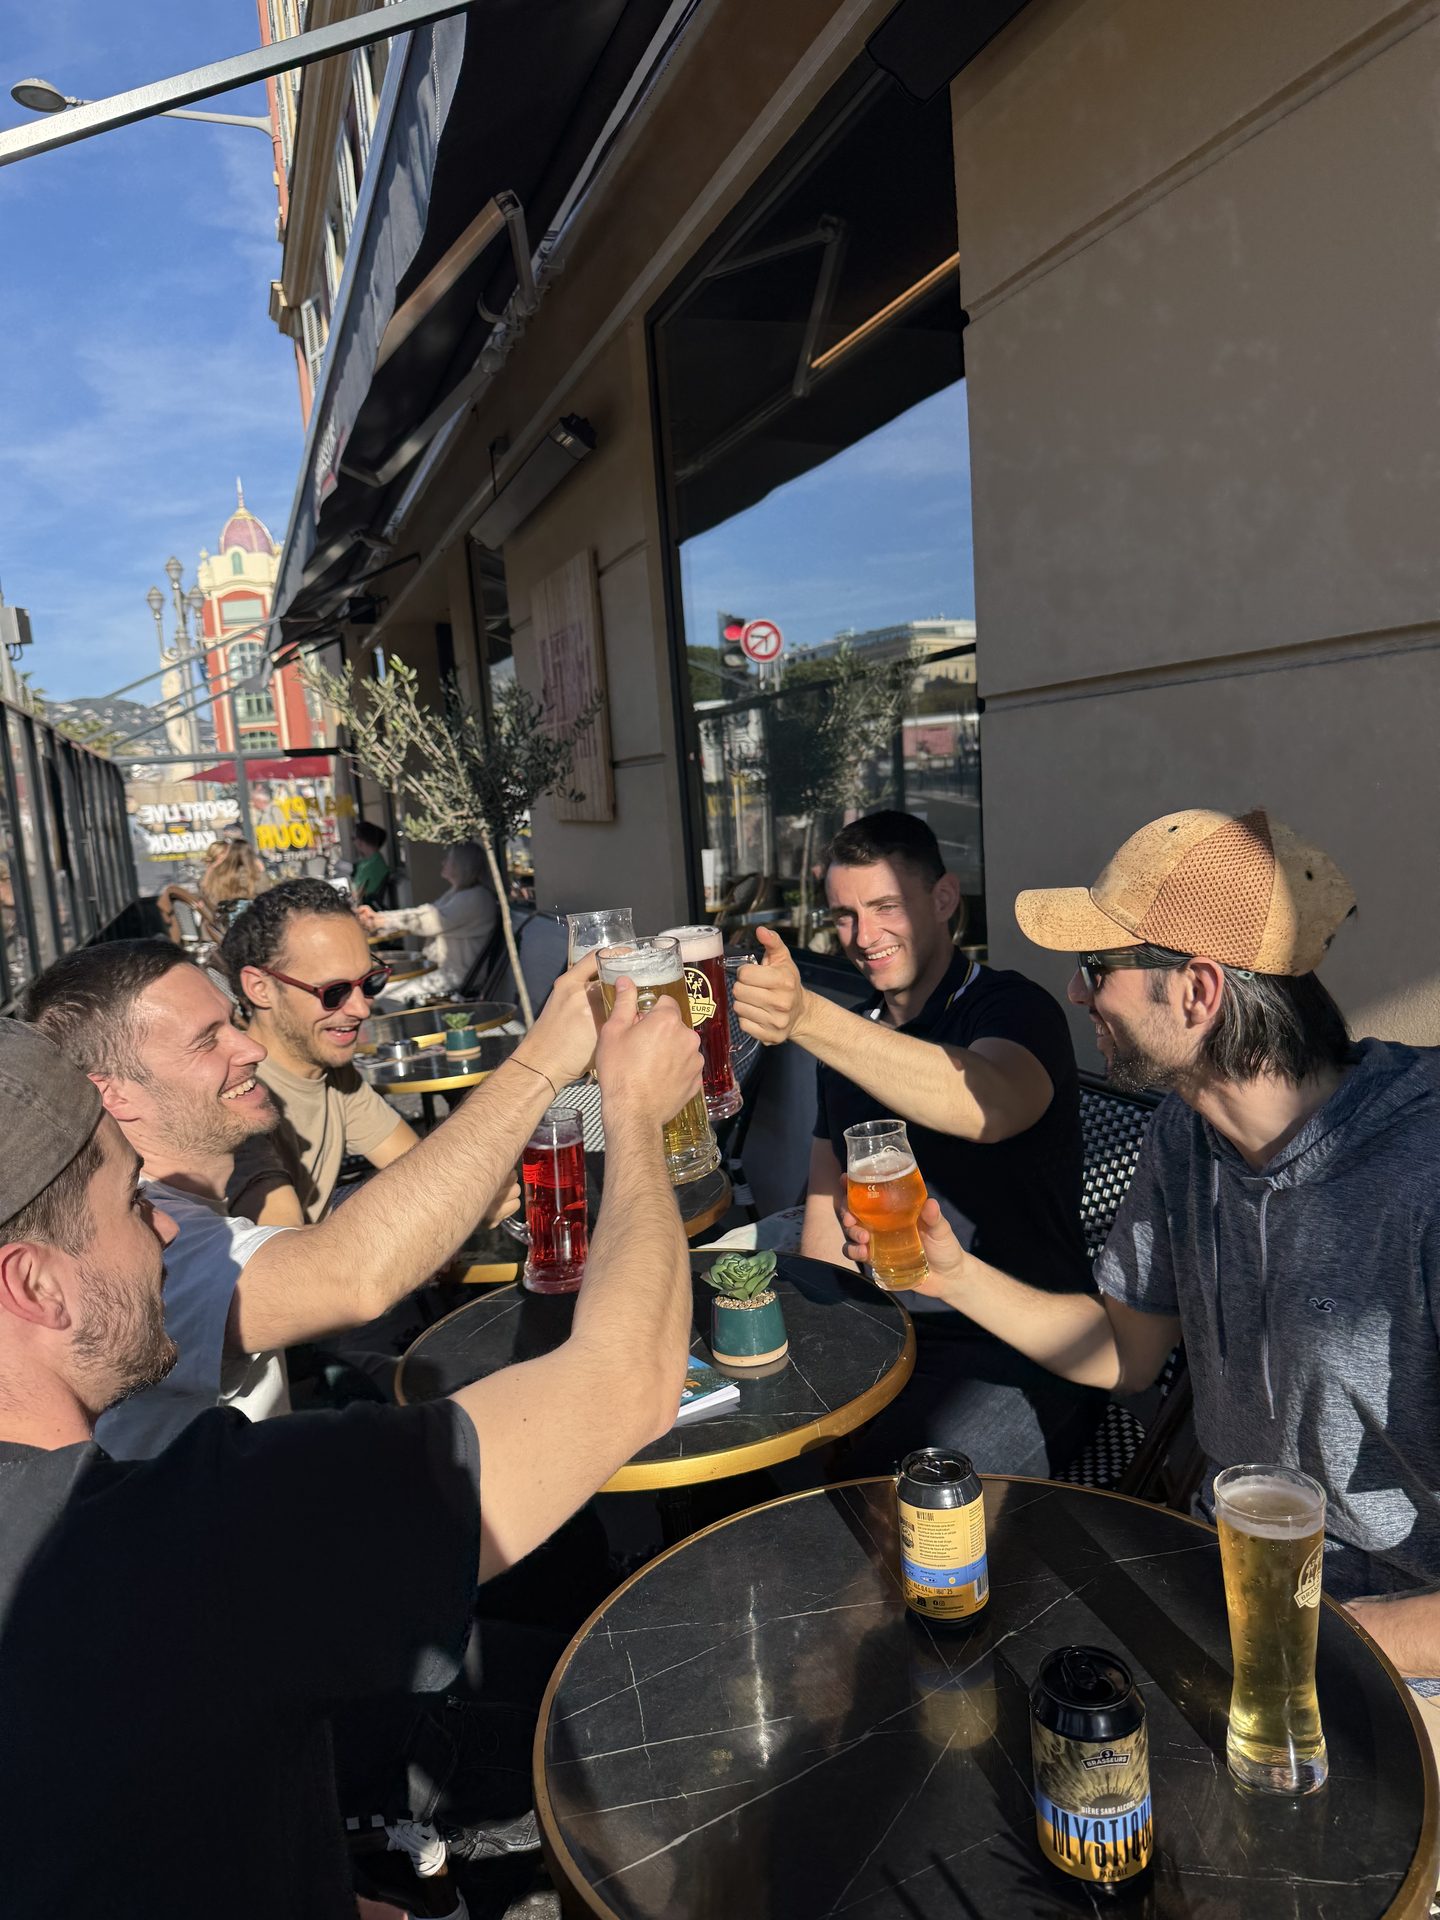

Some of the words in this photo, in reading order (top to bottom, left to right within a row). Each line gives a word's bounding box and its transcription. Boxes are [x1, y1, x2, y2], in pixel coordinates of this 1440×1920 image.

[1086, 1757, 1127, 1766] BRASSEURS
[1082, 1805, 1099, 1815] BIÈRE
[1101, 1807, 1115, 1815] SANS
